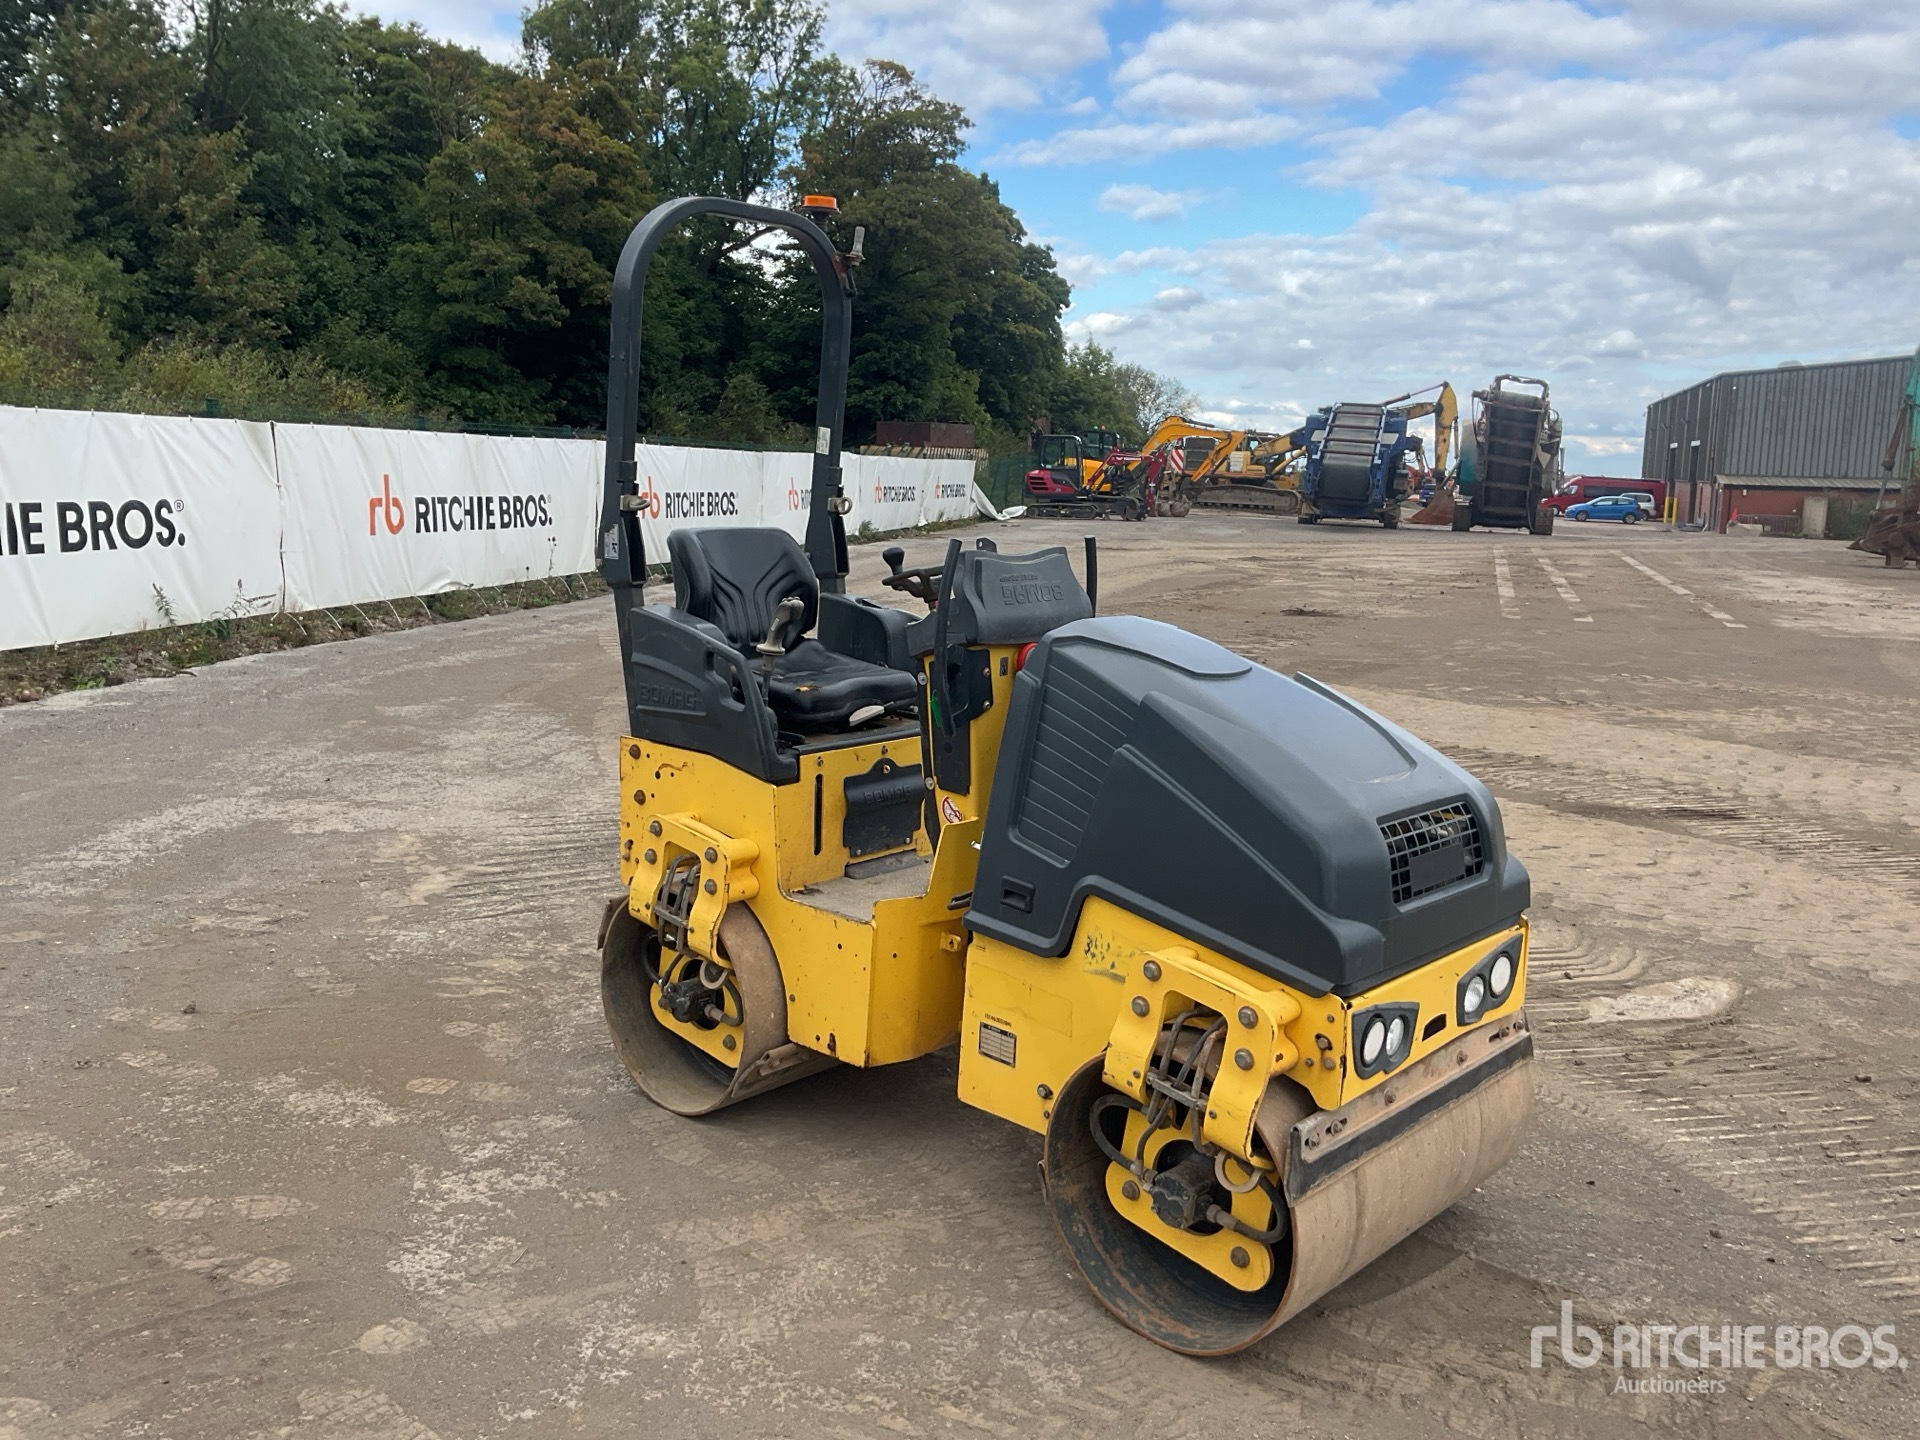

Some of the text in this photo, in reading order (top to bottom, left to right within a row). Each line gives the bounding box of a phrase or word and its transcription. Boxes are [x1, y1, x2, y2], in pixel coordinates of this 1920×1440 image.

[415, 496, 496, 533] RITCHIE
[665, 491, 705, 519] RITCHIE
[0, 502, 45, 556] IE
[639, 683, 697, 708] BOMAG
